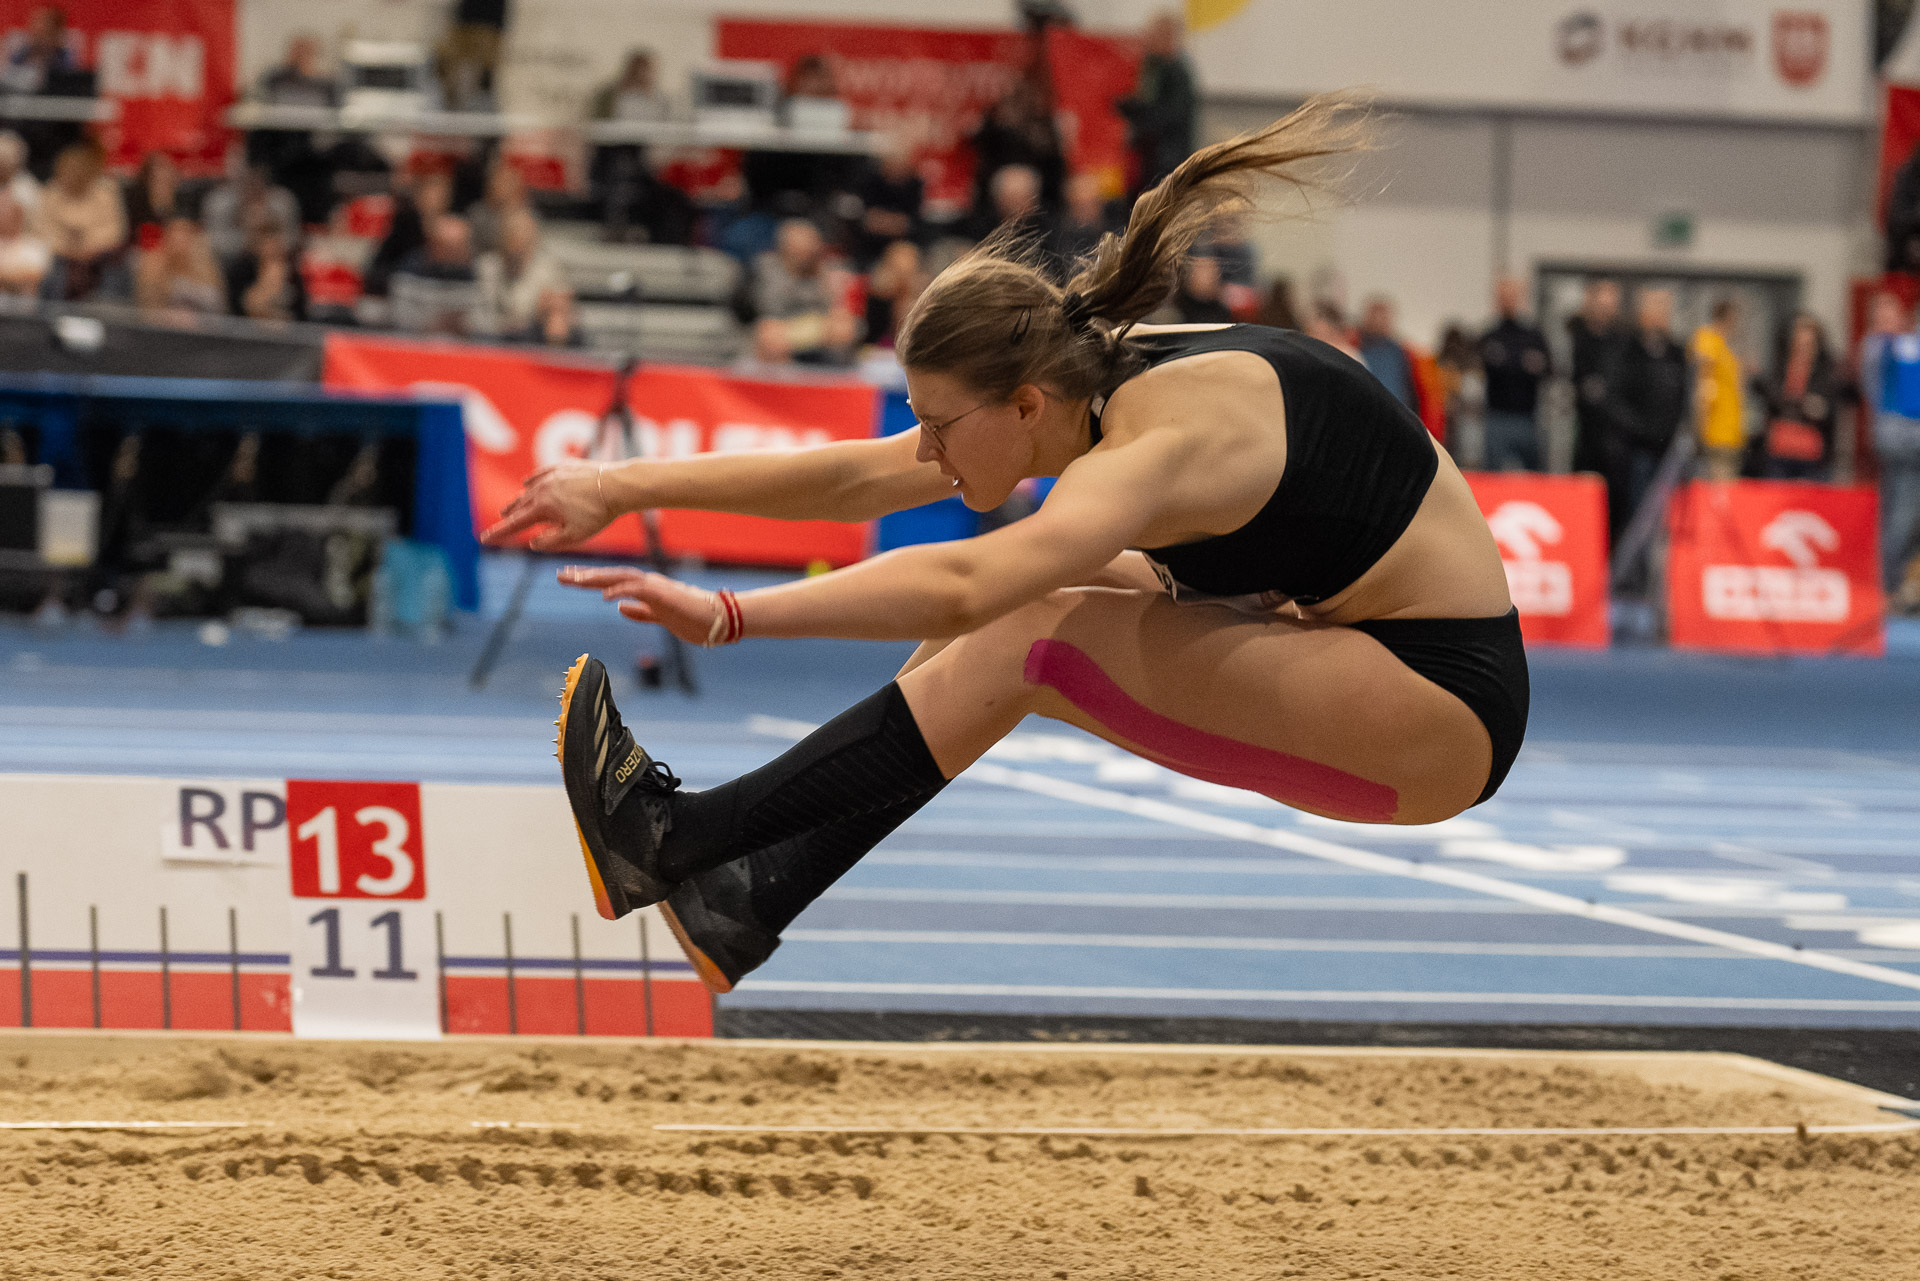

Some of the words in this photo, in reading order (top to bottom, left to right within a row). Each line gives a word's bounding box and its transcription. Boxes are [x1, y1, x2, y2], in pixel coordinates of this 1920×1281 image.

[178, 787, 287, 852] RP
[298, 805, 415, 896] 13
[308, 908, 418, 981] 11
